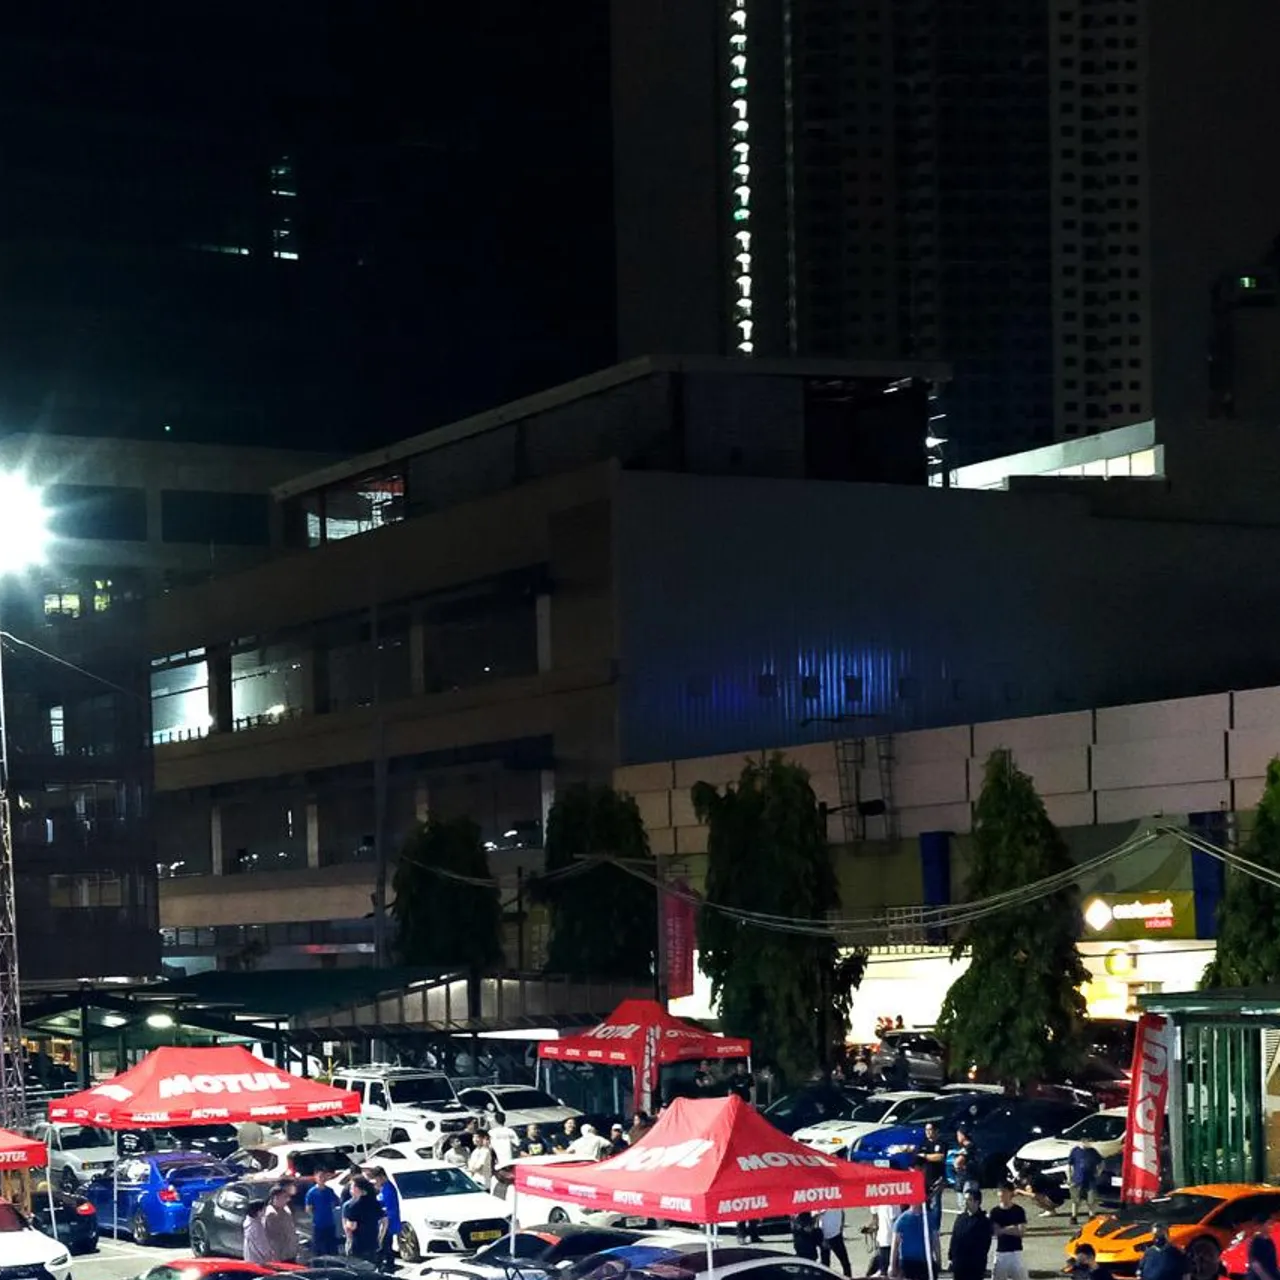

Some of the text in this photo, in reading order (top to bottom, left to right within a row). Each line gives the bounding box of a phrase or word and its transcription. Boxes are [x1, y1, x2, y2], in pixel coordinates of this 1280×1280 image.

[158, 1072, 291, 1099] MOTUL
[307, 1100, 345, 1112] MOTUL
[1131, 1025, 1172, 1175] MOTUL
[736, 1151, 838, 1172] MOTUL
[717, 1181, 914, 1214] MOTUL MOTUL MOTUL
